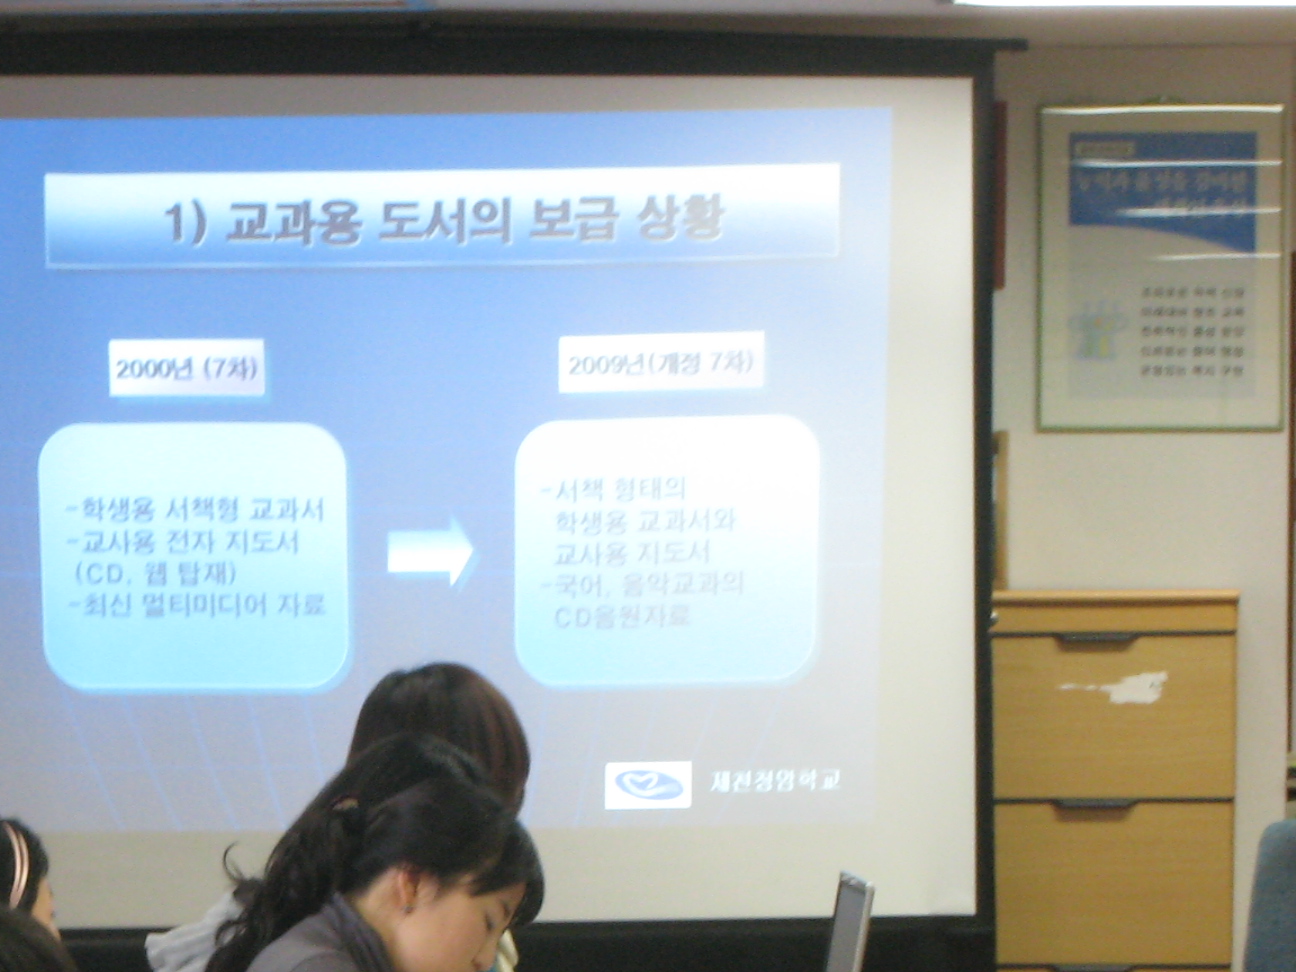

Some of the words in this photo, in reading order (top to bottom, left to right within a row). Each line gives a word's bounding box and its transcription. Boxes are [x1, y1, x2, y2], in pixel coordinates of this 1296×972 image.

[163, 200, 207, 245] 1)
[225, 199, 362, 247] 교과용
[378, 197, 512, 245] 도서의
[530, 196, 620, 242] 보급
[638, 192, 726, 242] 상황
[116, 356, 193, 381] 2000년
[204, 355, 258, 381] (7차)
[615, 475, 687, 502] 형태의
[166, 496, 239, 524] 서책형
[249, 496, 325, 522] 교과서
[555, 509, 628, 536] 학생용
[637, 507, 736, 533] 교과서와
[167, 529, 215, 555] 전자
[226, 528, 300, 555] 지도서
[554, 541, 628, 567] 교사용
[637, 539, 711, 566] 지도서
[145, 560, 167, 587] 웹
[178, 560, 238, 587] 탑재)
[623, 570, 745, 598] 음악교과의
[142, 592, 268, 619] 멀티미디어
[278, 591, 327, 619] 자료
